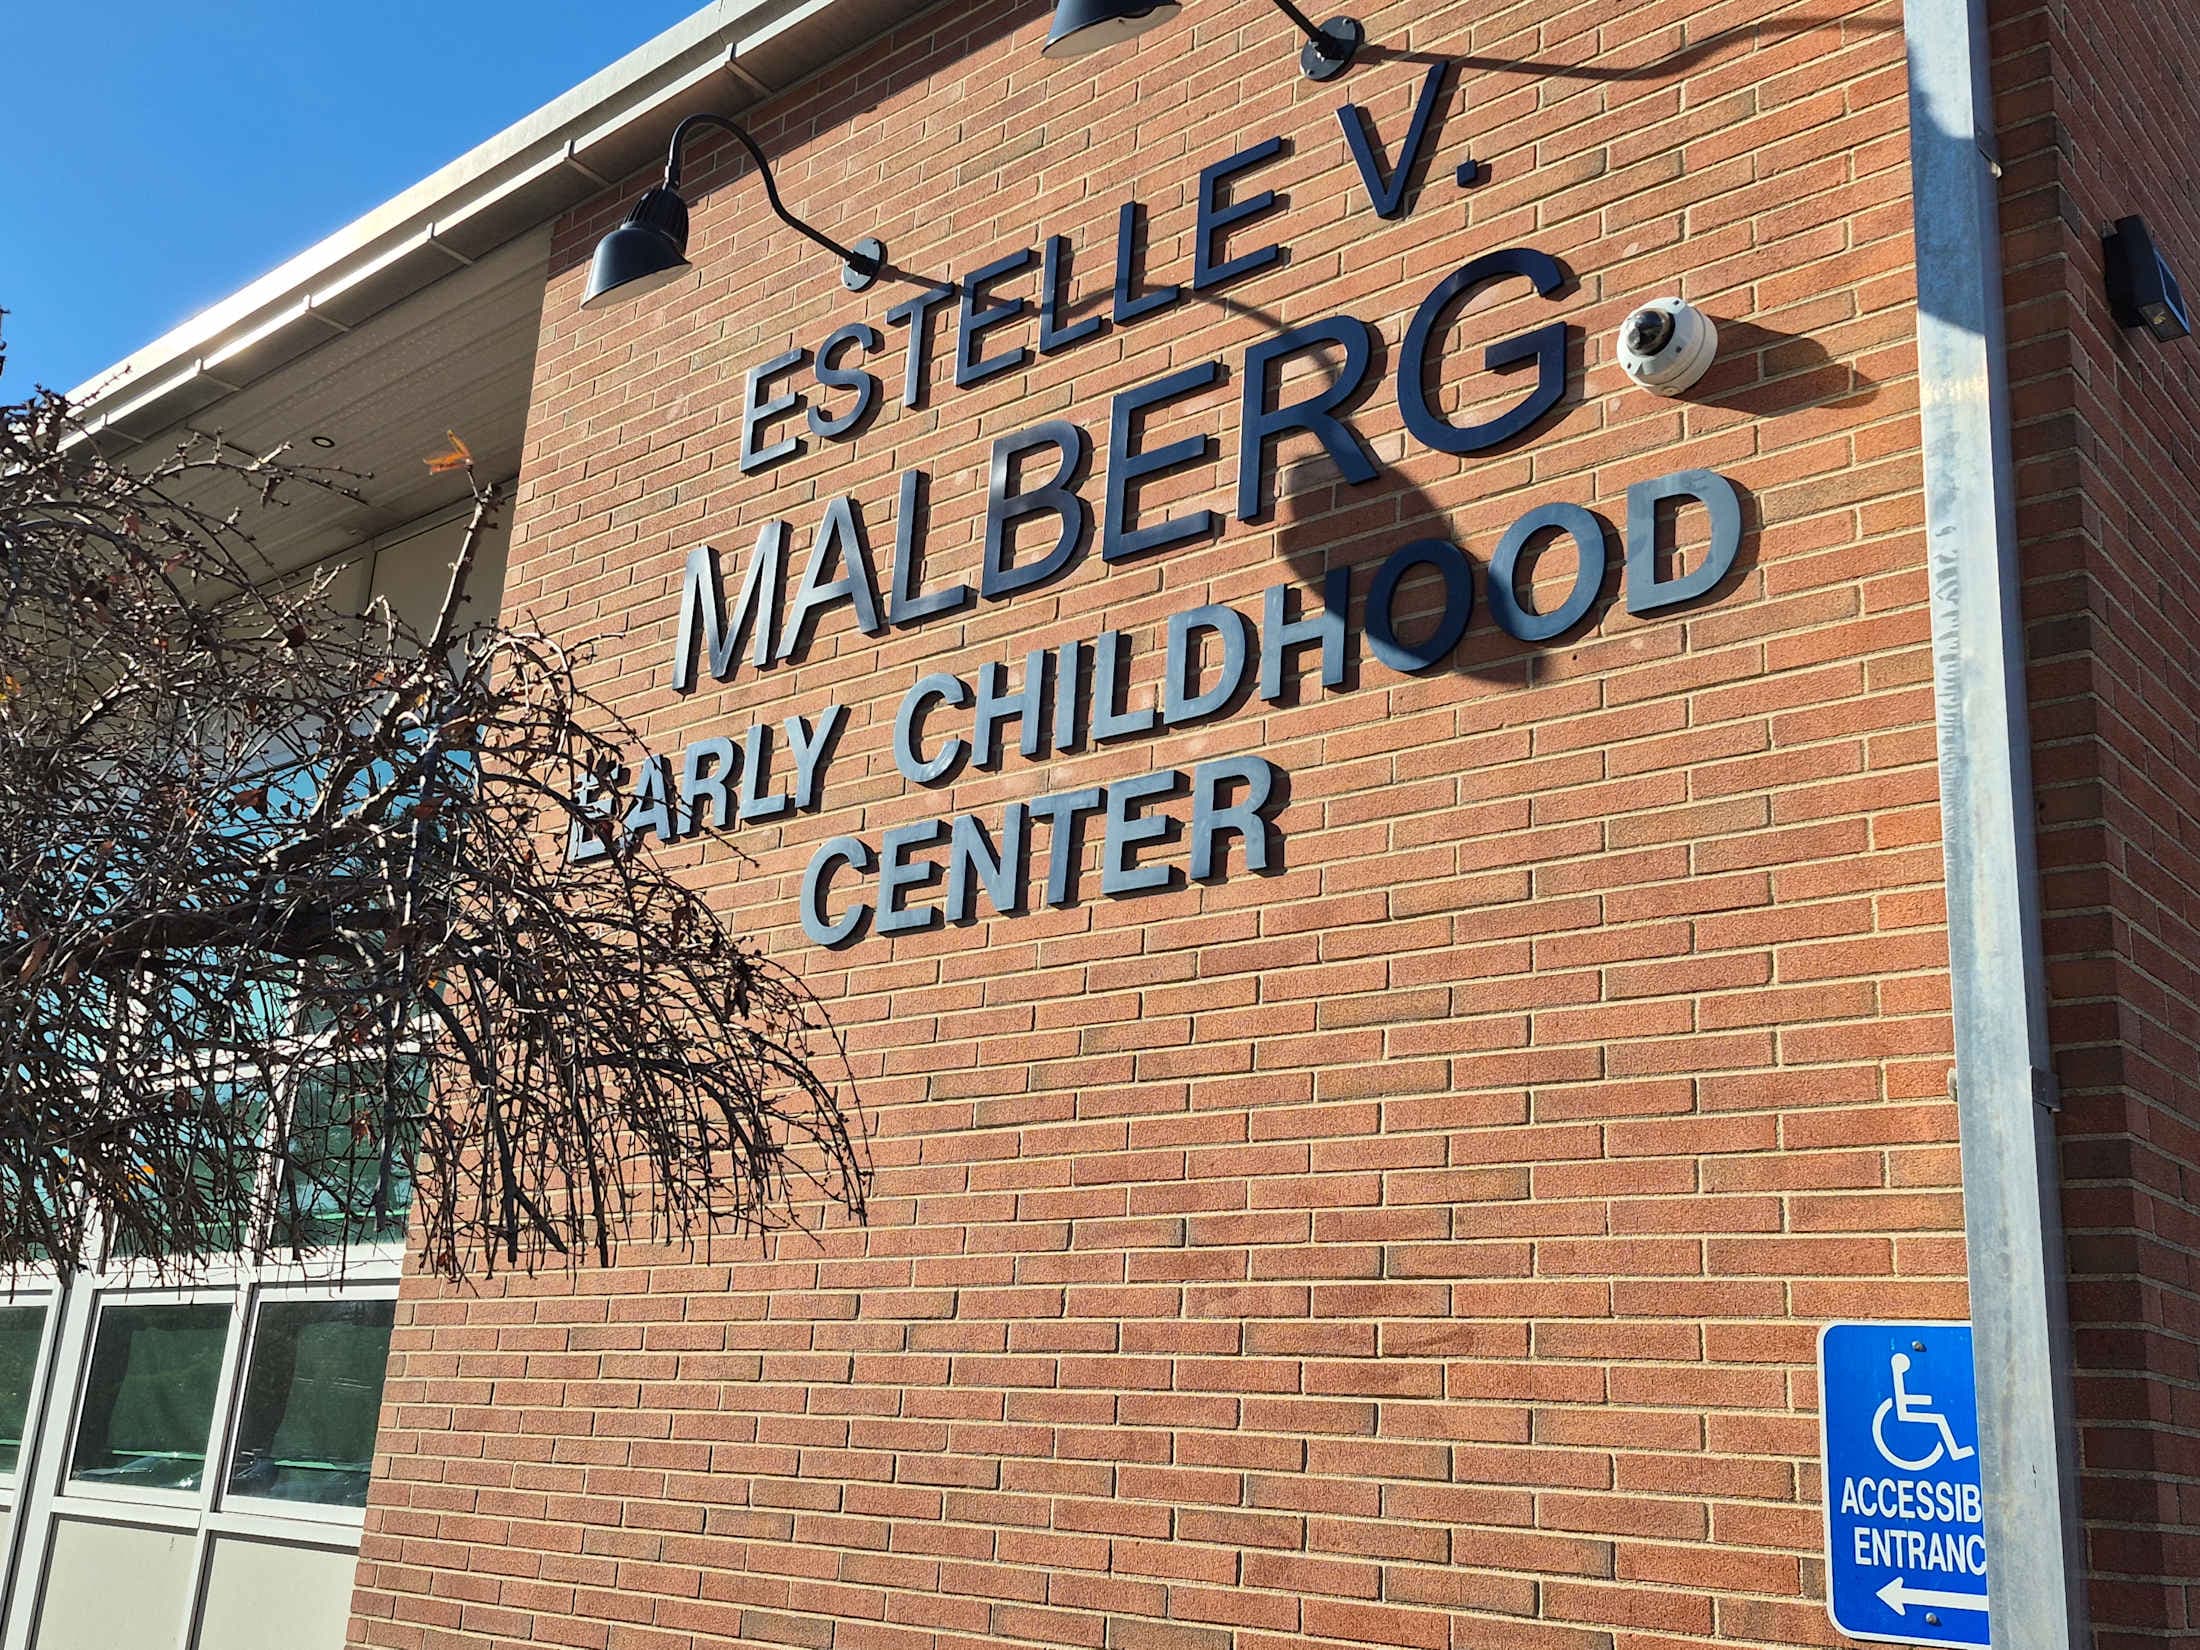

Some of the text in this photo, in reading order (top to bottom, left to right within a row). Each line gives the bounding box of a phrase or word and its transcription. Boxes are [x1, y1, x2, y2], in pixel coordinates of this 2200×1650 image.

[741, 61, 1478, 472] ESTELLE V.
[568, 470, 1743, 864] EARLY CHILDHOOD
[673, 248, 1569, 692] MALBERG
[800, 756, 1274, 947] CENTER
